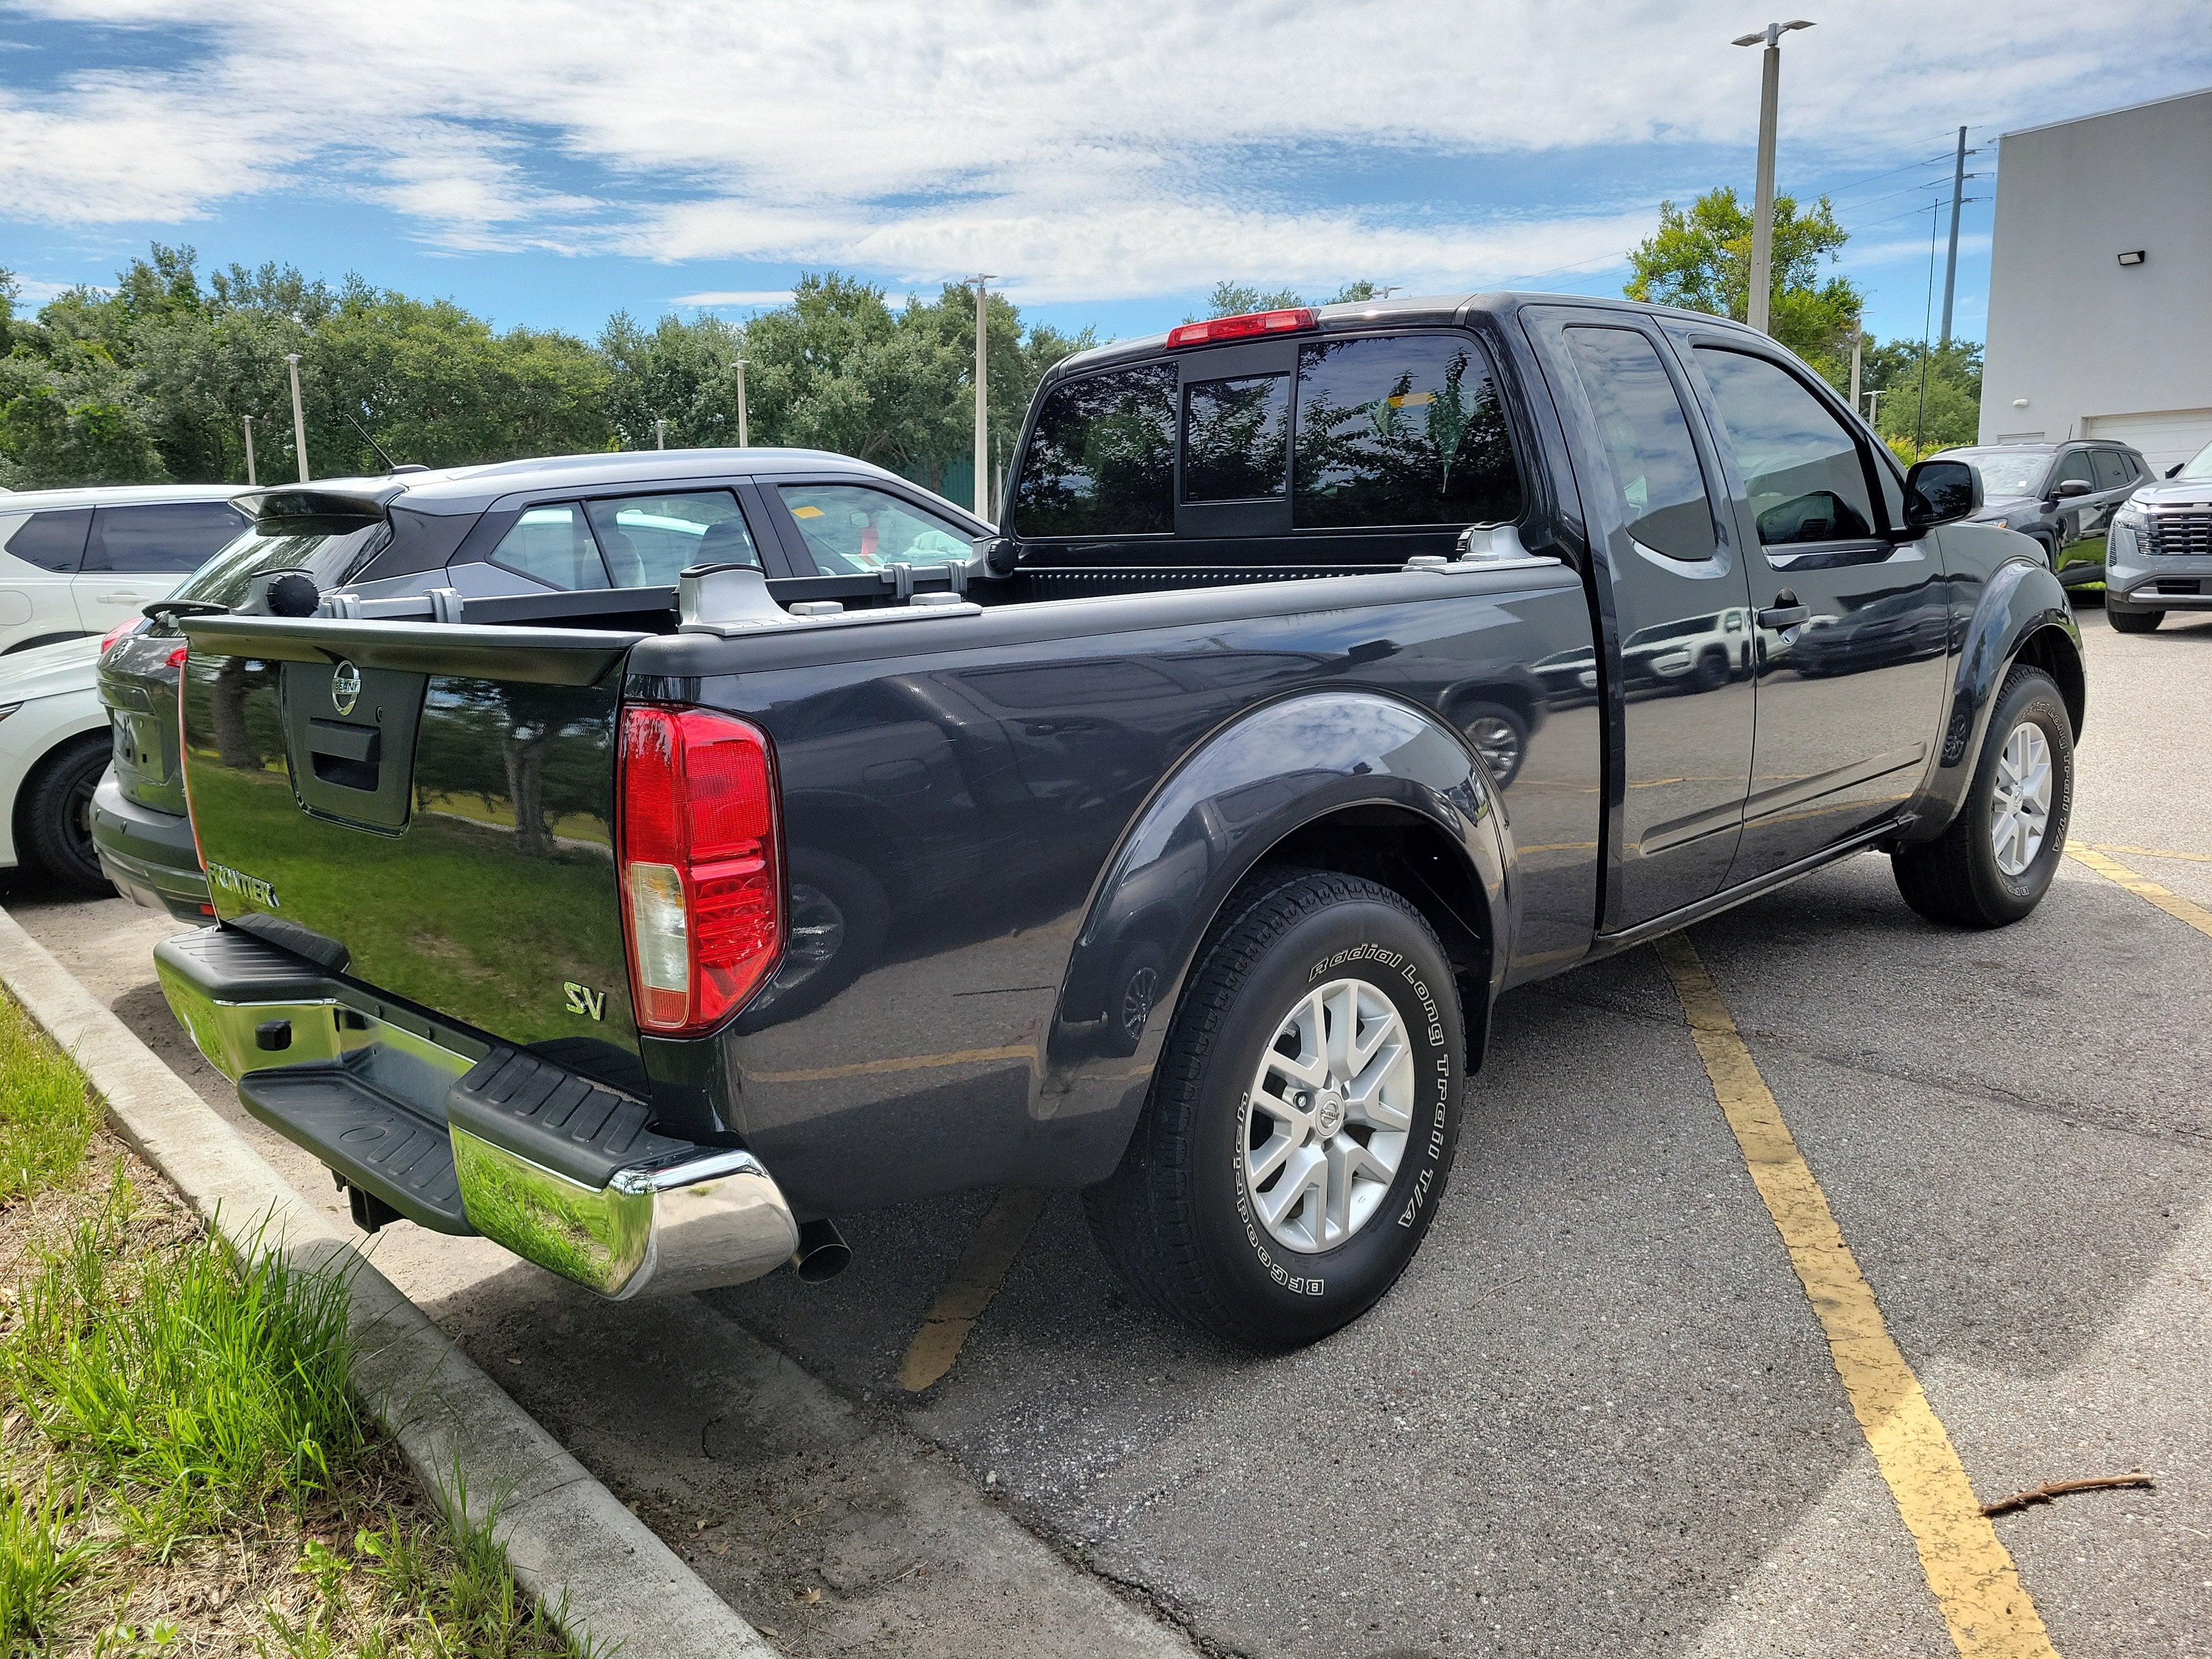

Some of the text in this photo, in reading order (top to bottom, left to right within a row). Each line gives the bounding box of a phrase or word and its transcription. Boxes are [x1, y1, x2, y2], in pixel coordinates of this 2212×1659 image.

[2048, 707, 2068, 749] Long
[563, 981, 606, 1021] SV
[1308, 943, 1449, 1228] Radial Long Trail T/A
[1232, 1092, 1325, 1296] BFGoodrich
